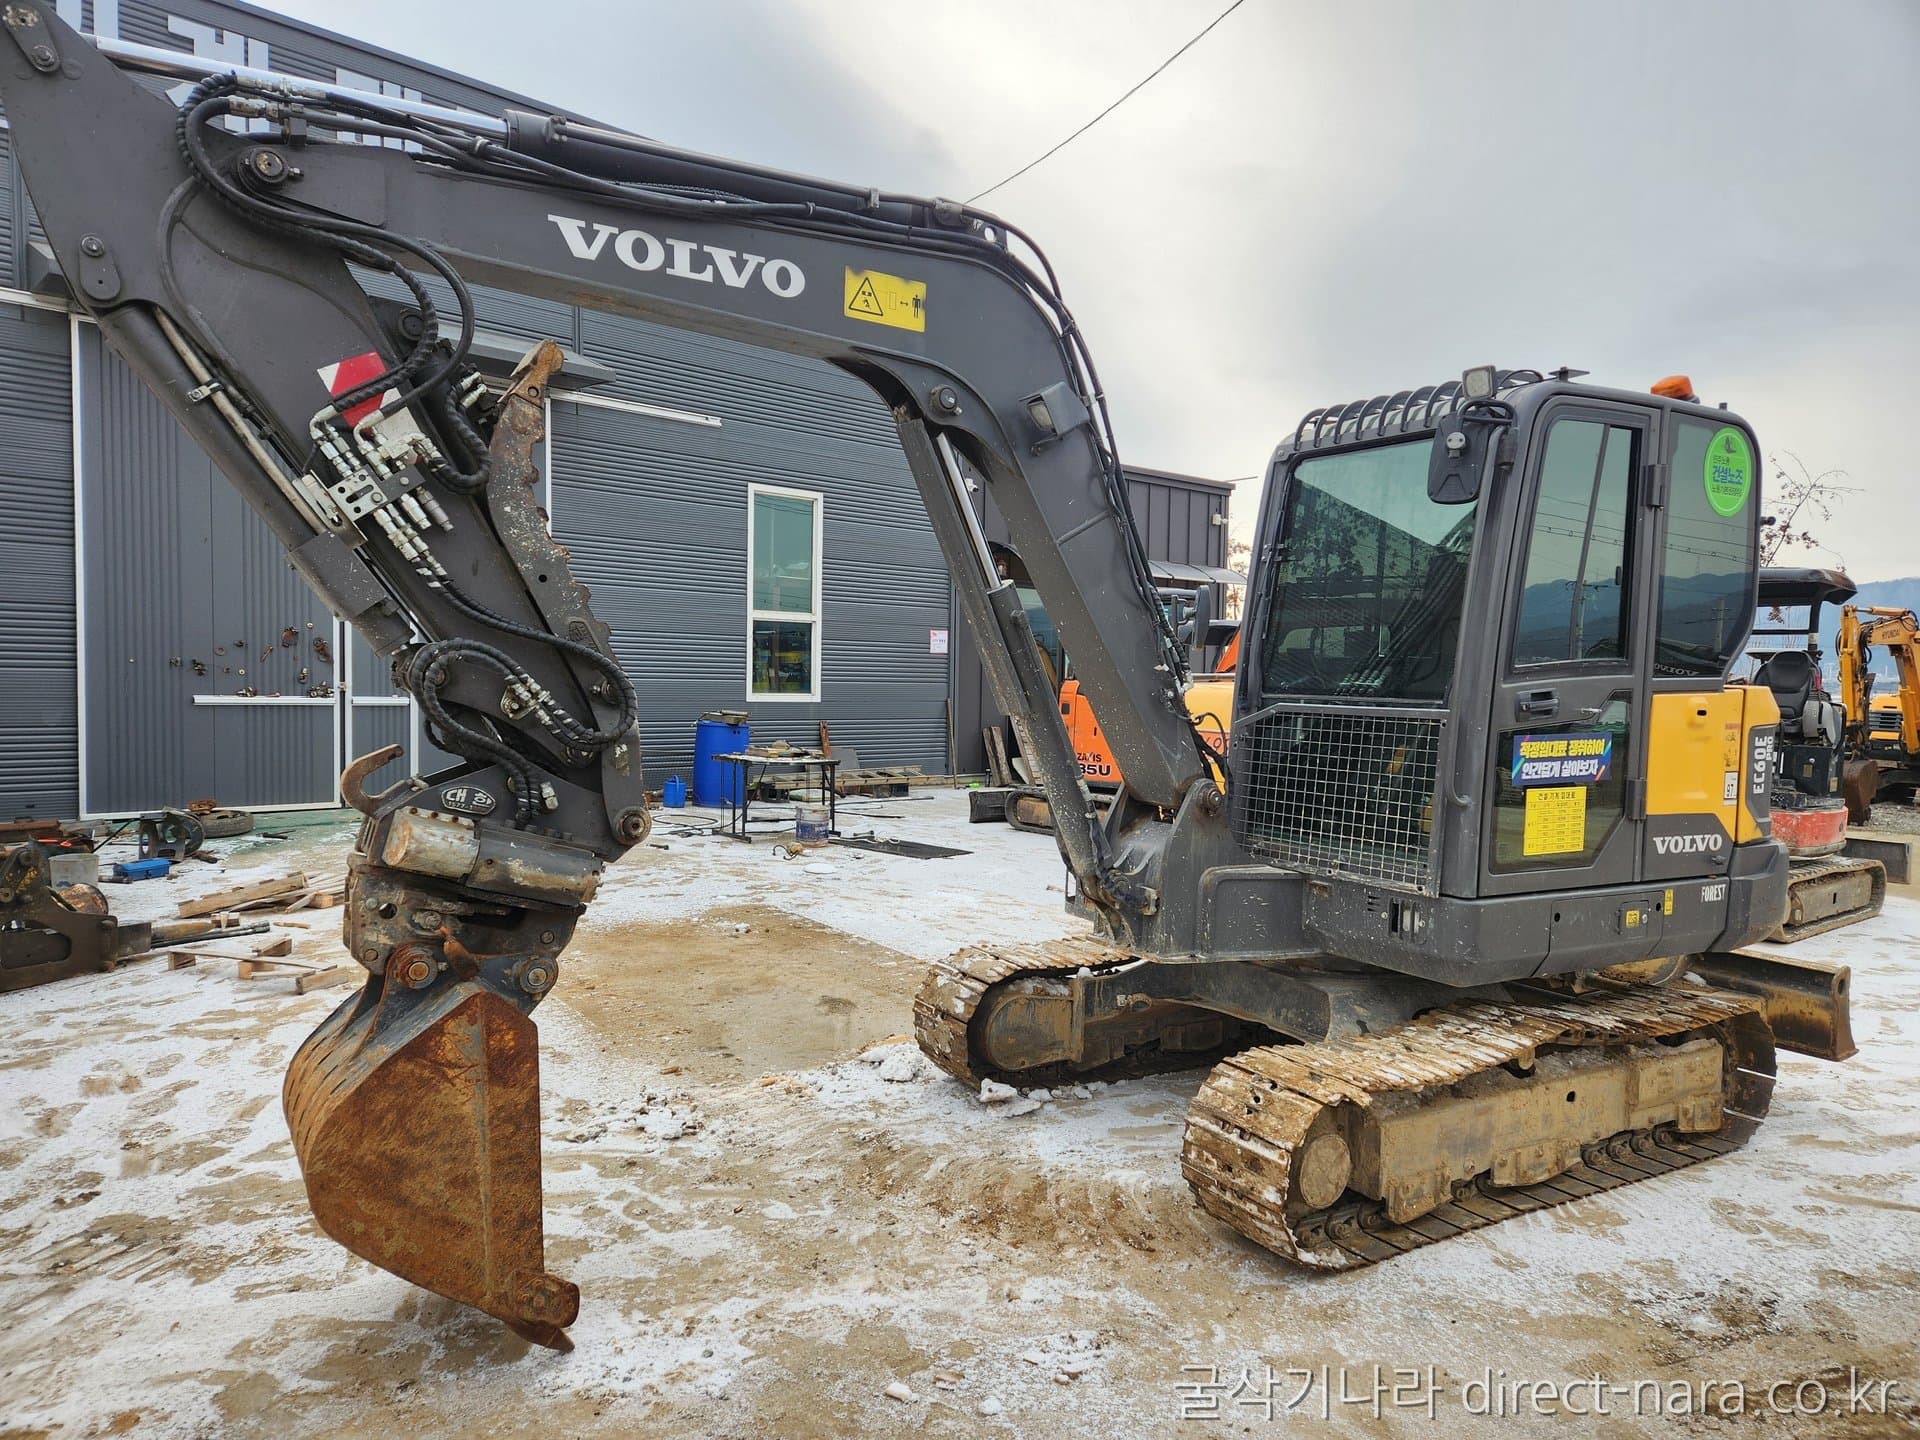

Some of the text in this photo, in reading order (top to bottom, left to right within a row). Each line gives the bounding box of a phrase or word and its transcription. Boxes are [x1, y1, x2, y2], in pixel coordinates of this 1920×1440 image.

[547, 214, 806, 298] VOLVO
[1712, 465, 1743, 485] 건설노조
[1520, 739, 1605, 758] 적정임대료 쟁취하여
[1766, 736, 1774, 761] PRO
[1521, 759, 1599, 779] 인간답게 살아보자
[1753, 736, 1768, 794] EC60E
[1653, 834, 1722, 854] VOLVO
[1700, 884, 1726, 903] FOREST
